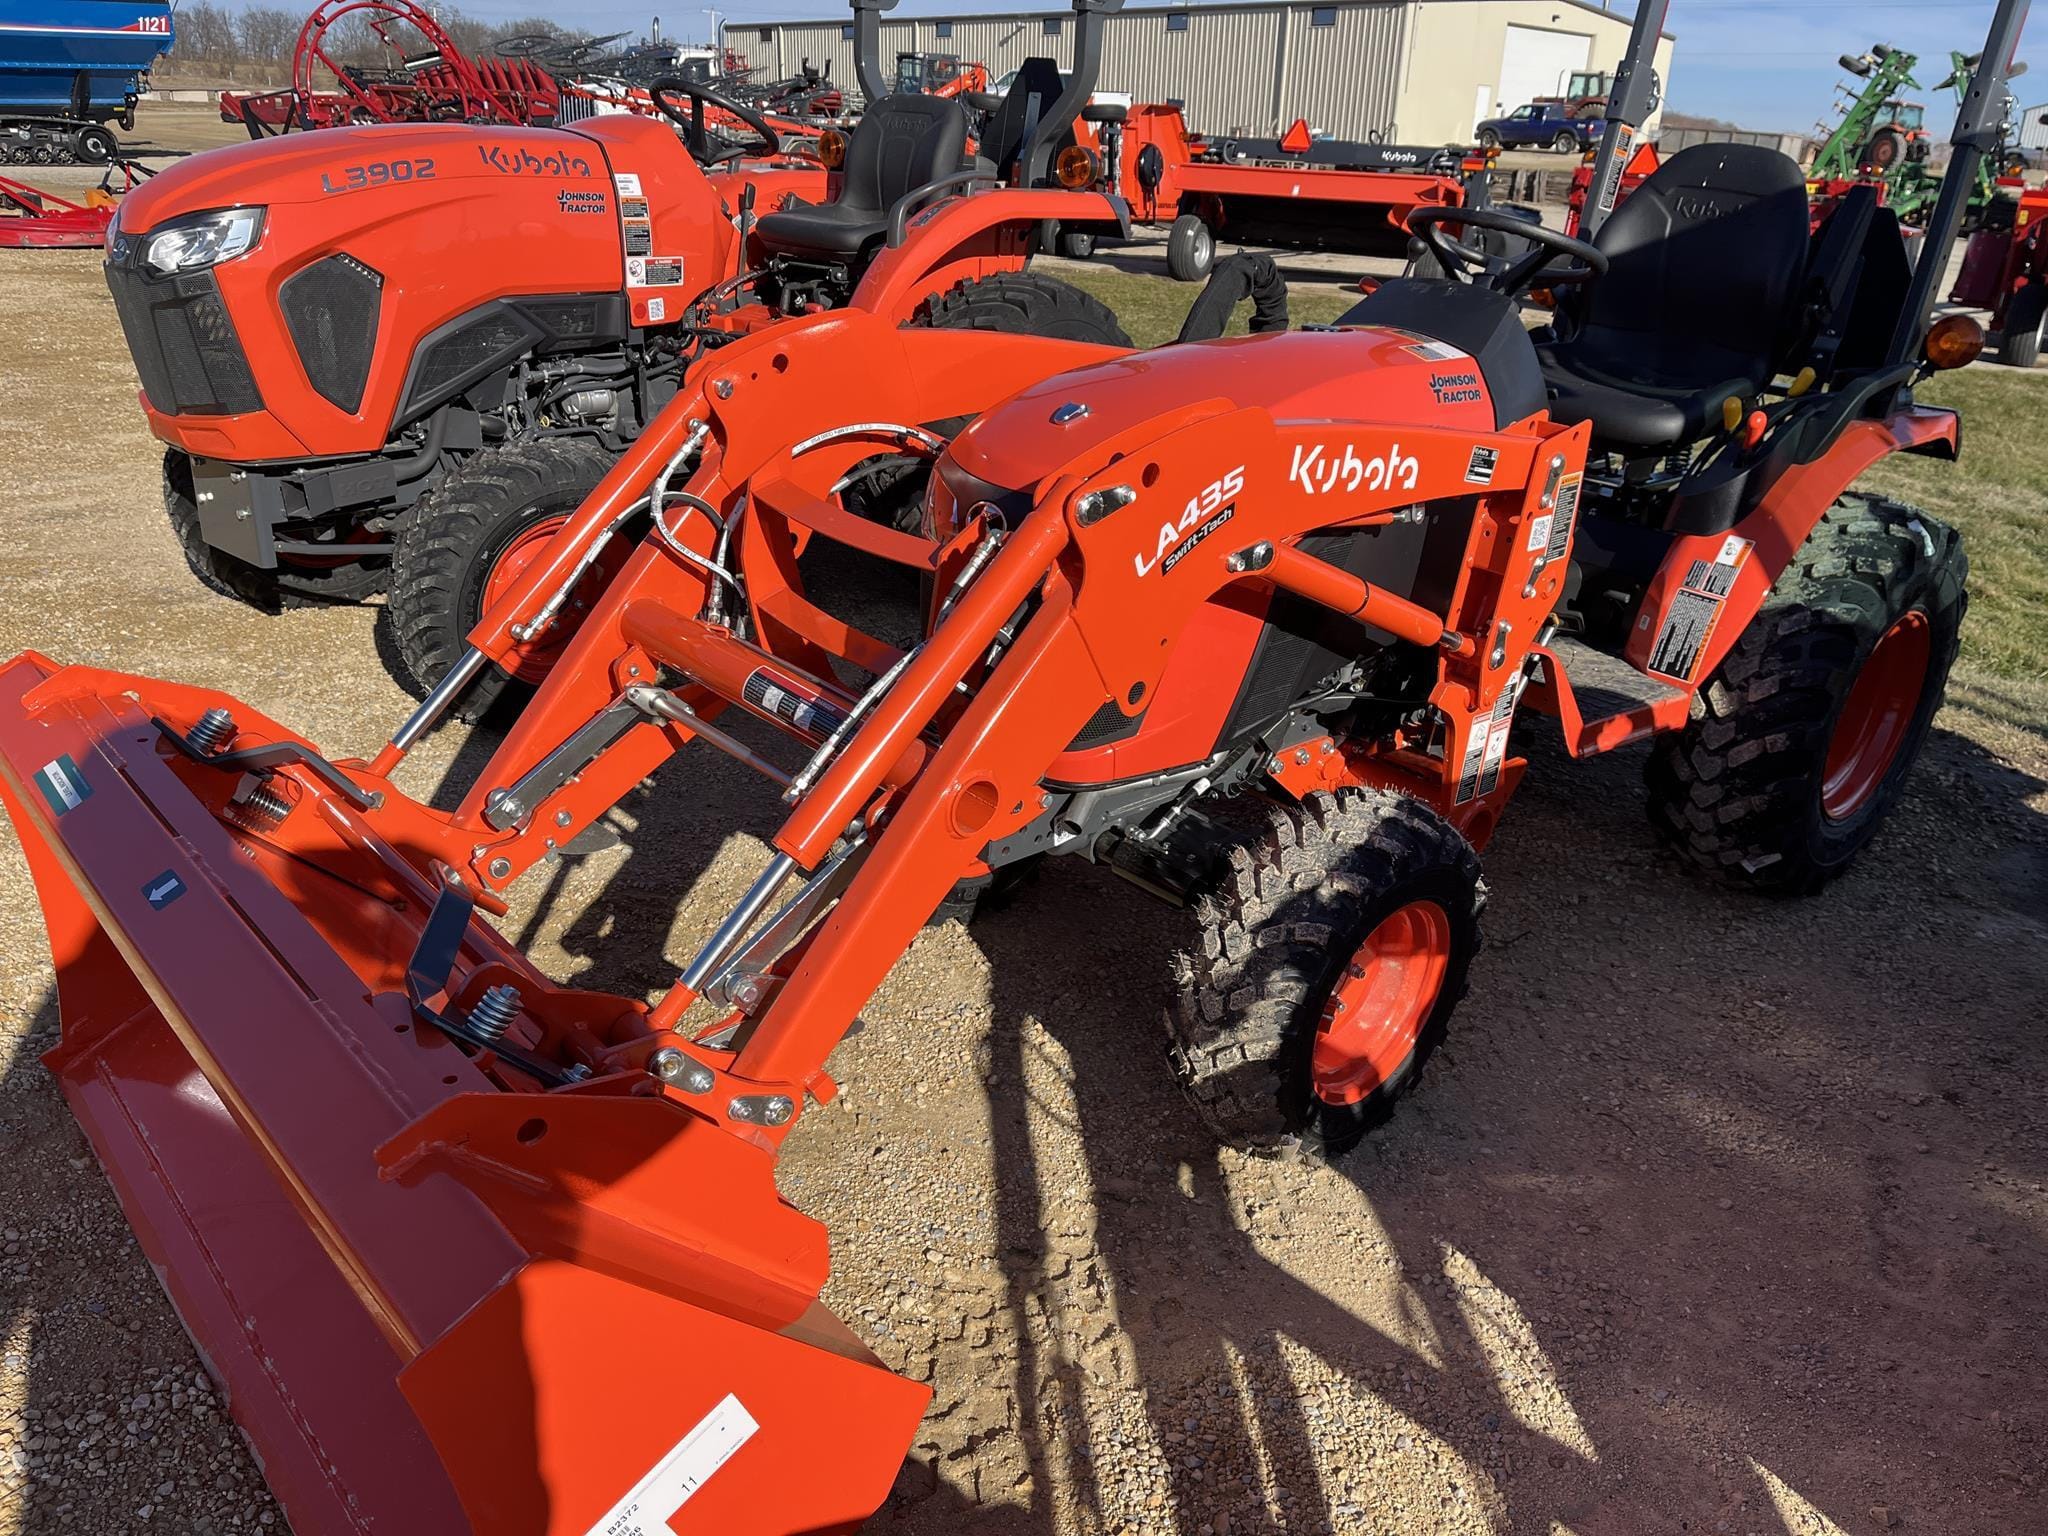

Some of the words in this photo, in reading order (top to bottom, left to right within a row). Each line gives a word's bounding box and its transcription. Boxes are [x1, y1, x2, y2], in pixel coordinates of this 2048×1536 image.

[138, 16, 166, 31] 1121
[478, 145, 591, 177] Kubota
[1382, 151, 1417, 163] Kubota
[321, 158, 436, 194] L3902
[557, 189, 605, 201] JOHNSON
[559, 201, 606, 213] TRACTOR
[1429, 373, 1477, 388] JOHNSON
[1433, 388, 1481, 404] TRACTOR
[1289, 443, 1419, 494] Kubota
[1134, 464, 1245, 578] LA435
[1165, 508, 1233, 572] Swift-Tach
[607, 1503, 640, 1536] B2372
